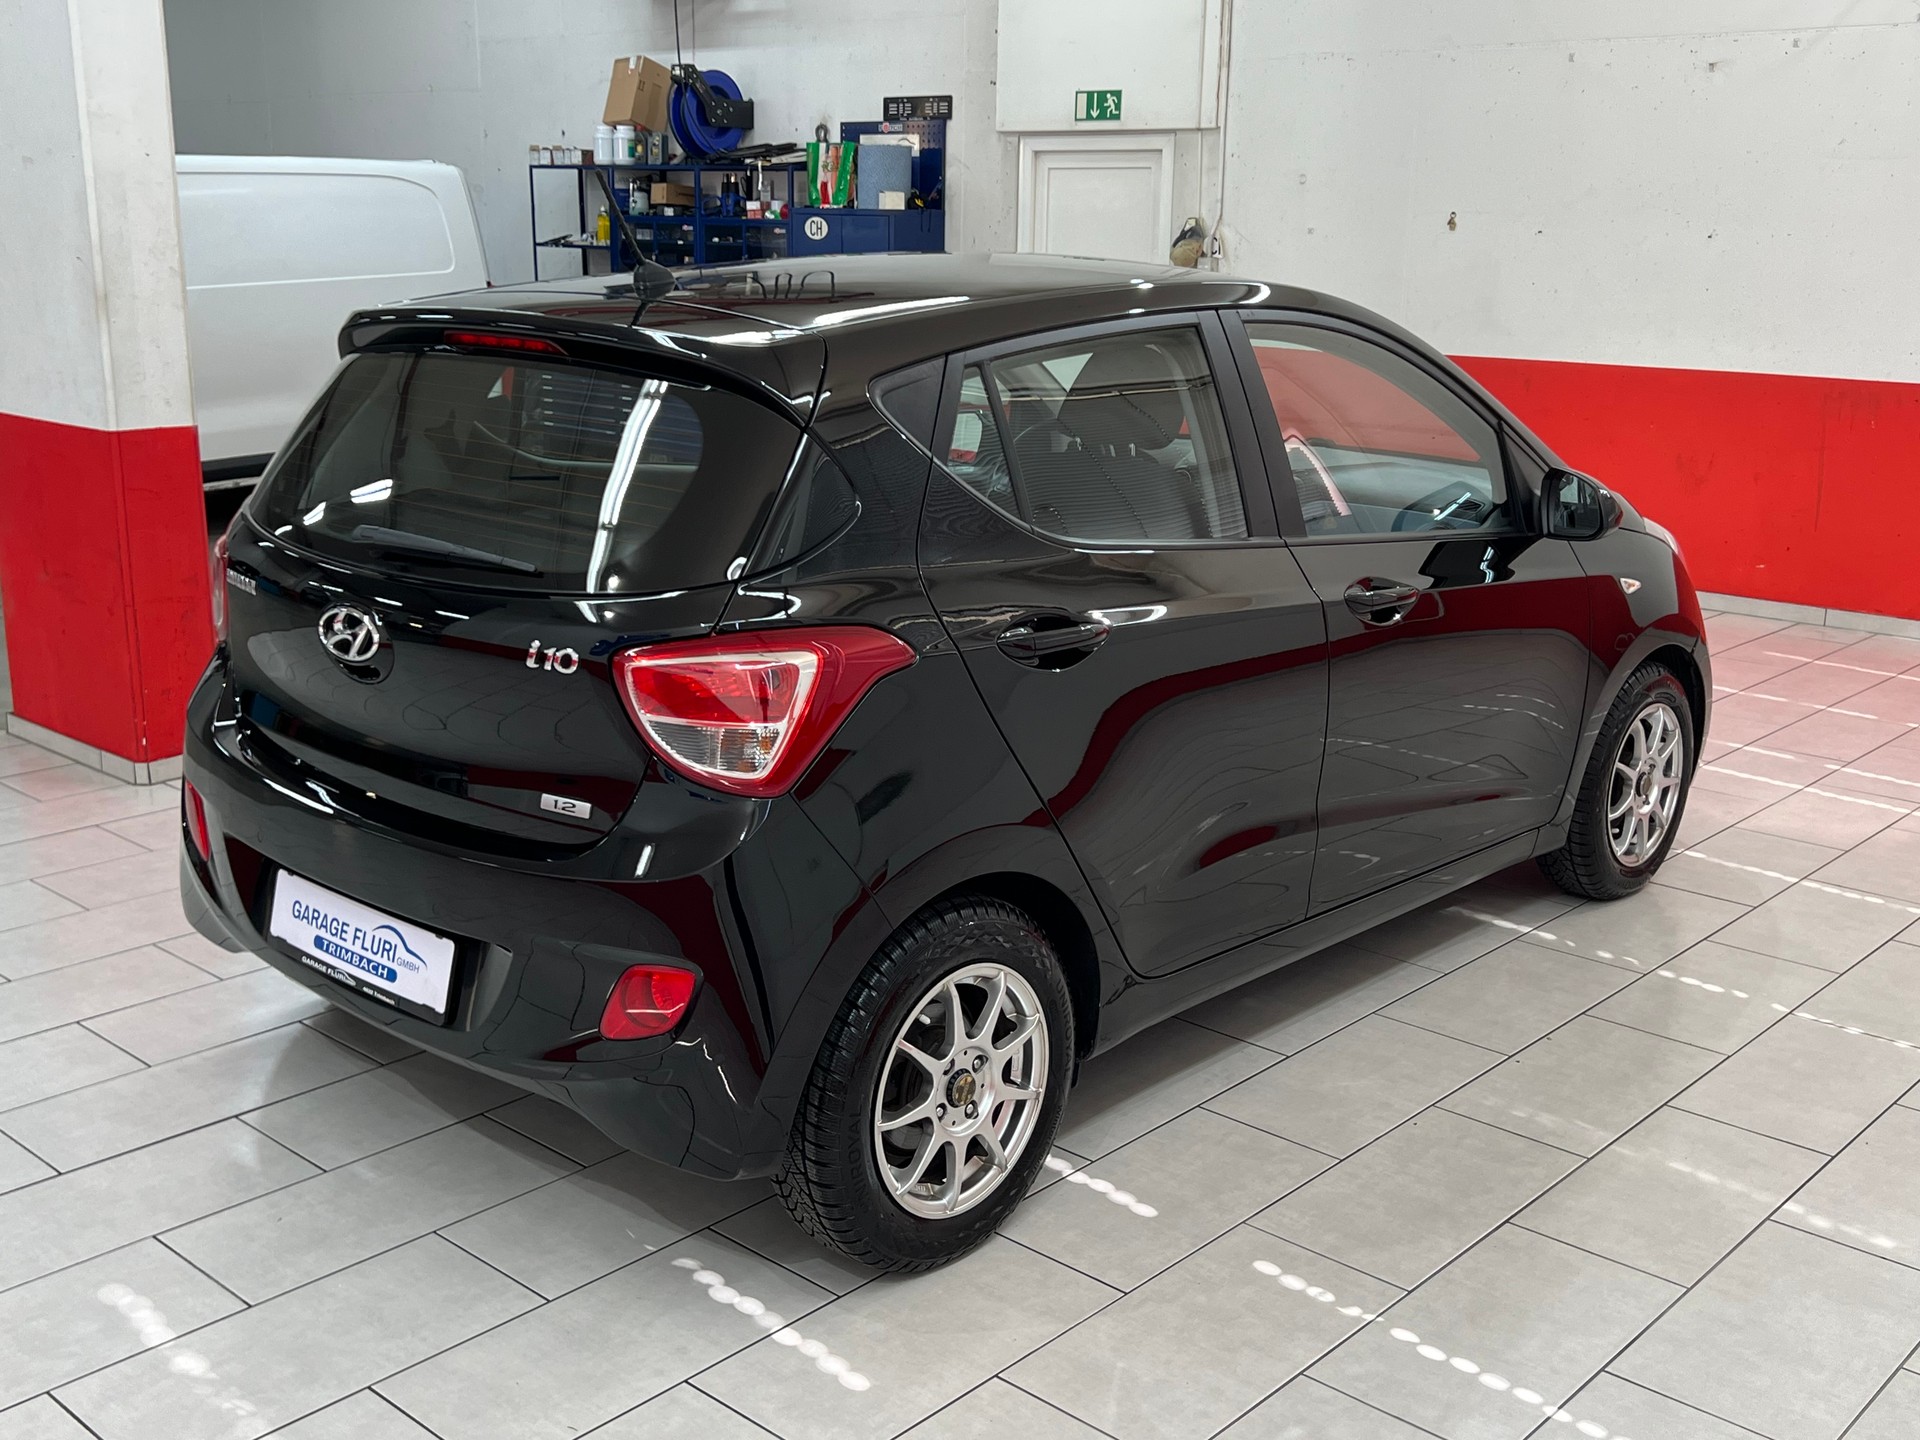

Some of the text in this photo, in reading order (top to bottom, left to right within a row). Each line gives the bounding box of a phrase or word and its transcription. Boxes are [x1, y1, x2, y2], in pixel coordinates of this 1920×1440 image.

[810, 220, 822, 236] CH
[526, 639, 579, 675] i10
[553, 799, 577, 814] 1.2
[292, 900, 420, 974] GARAGE FLURI GMBH
[301, 955, 327, 974] GARAGE
[322, 939, 389, 979] TRIMBACH
[1056, 980, 1075, 1077] UNIROYAL
